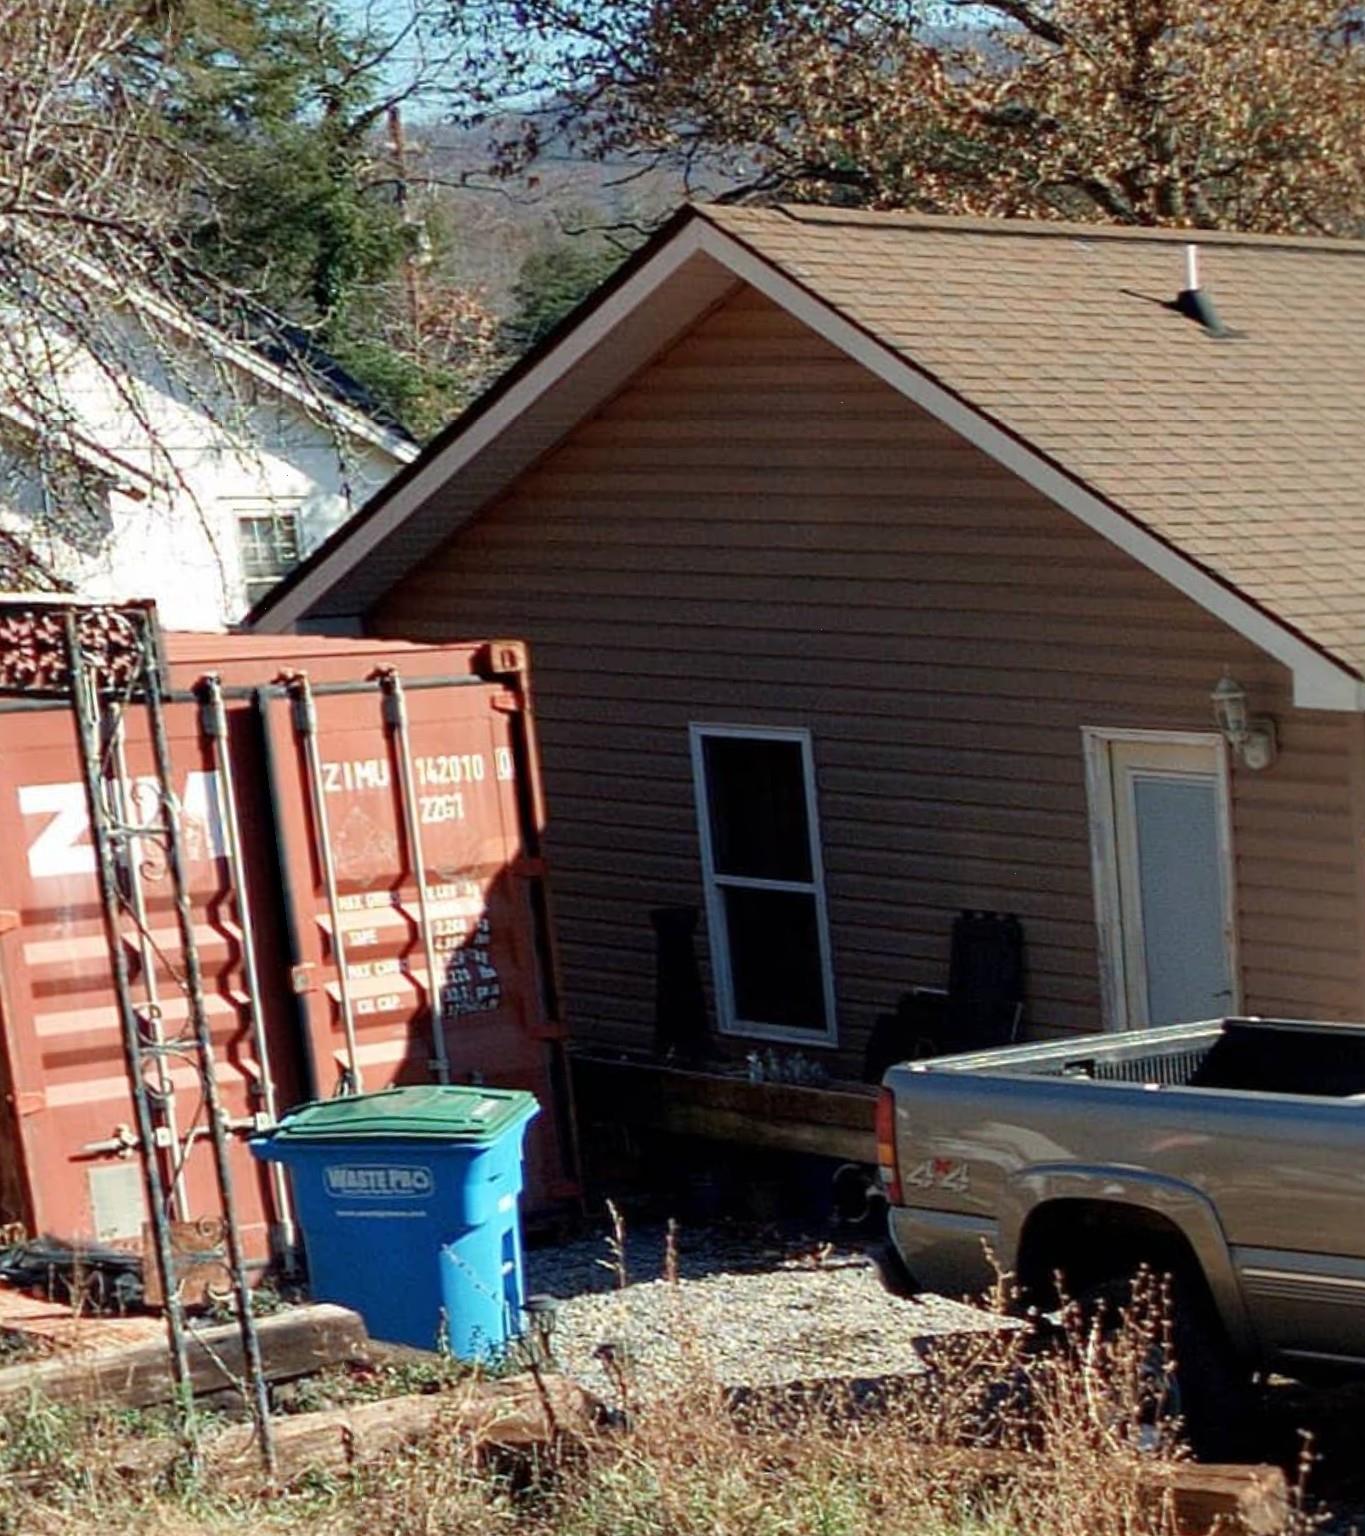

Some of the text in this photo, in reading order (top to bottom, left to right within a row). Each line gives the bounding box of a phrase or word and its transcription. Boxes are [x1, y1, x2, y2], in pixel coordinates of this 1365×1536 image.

[322, 759, 389, 792] ZIMU
[415, 754, 484, 785] 142010
[328, 1169, 429, 1189] WASTE PRO
